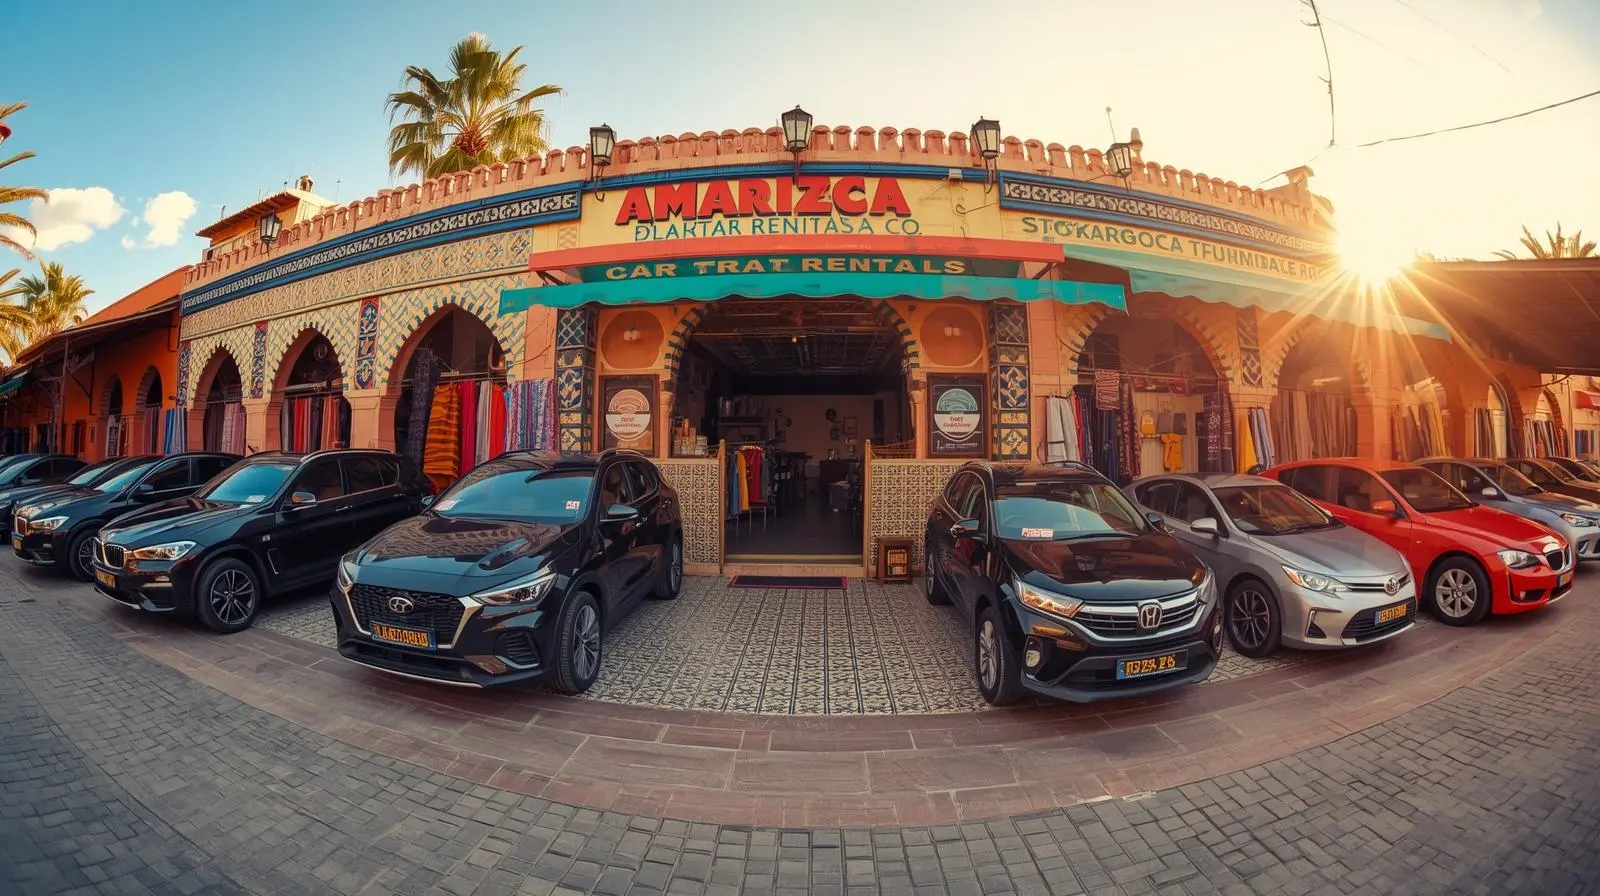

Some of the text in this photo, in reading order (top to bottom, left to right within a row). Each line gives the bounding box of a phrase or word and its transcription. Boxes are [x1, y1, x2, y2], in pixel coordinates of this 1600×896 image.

[614, 175, 912, 226] AMARIZCA
[885, 218, 922, 235] CO.
[605, 257, 966, 280] CAR TRAT RENTALS
